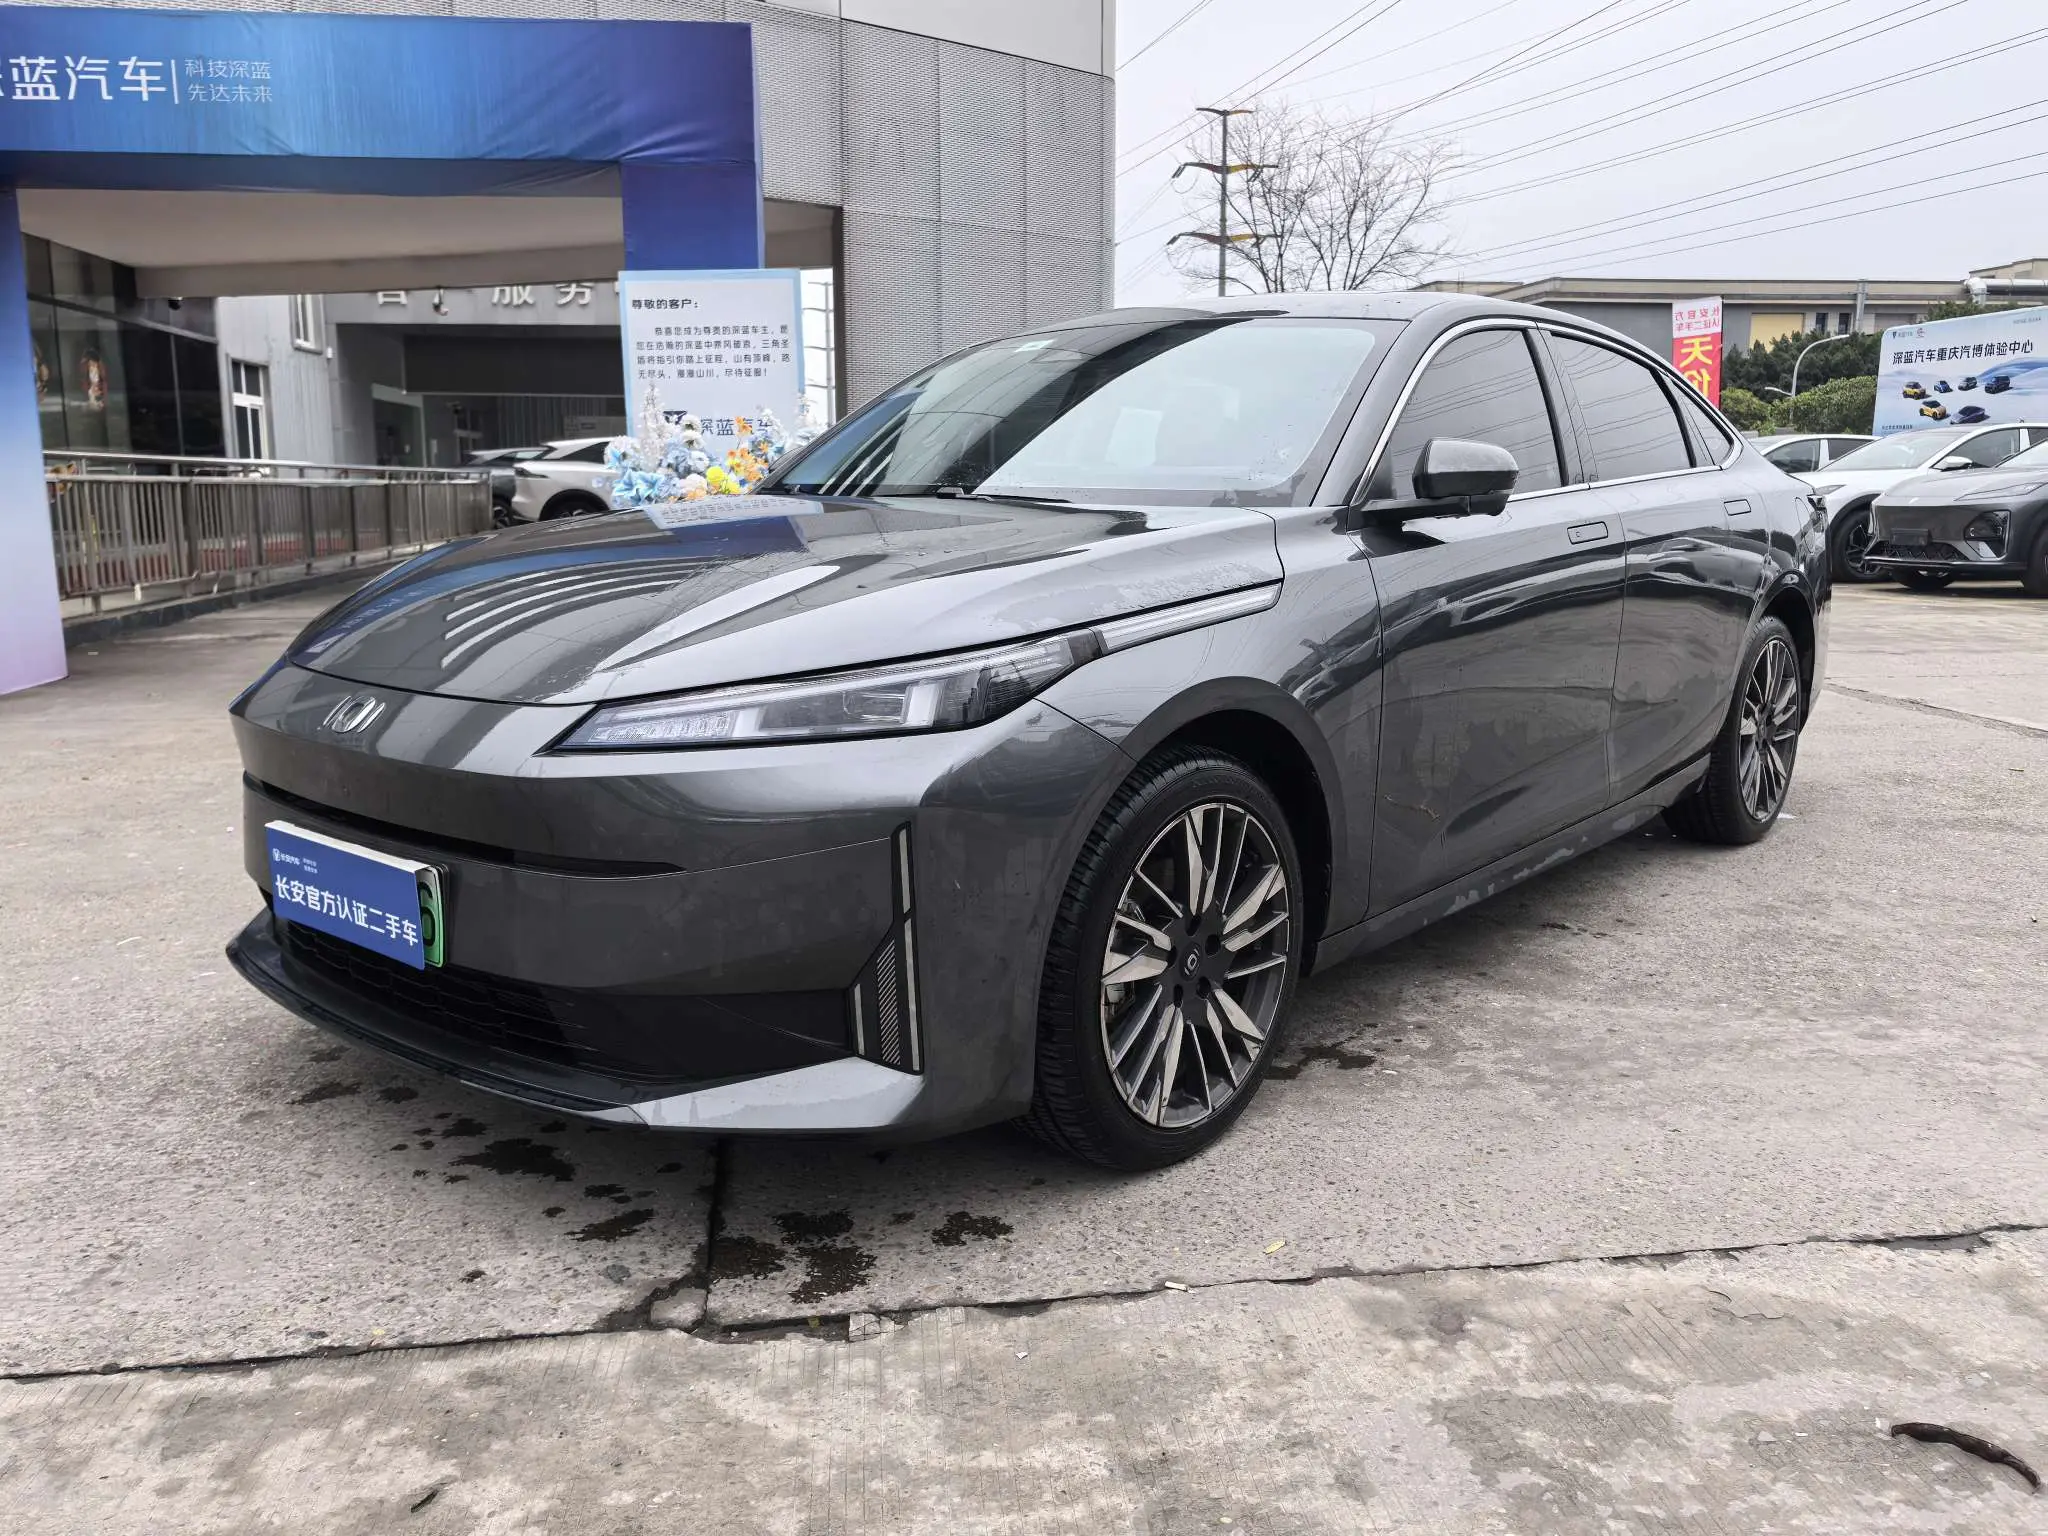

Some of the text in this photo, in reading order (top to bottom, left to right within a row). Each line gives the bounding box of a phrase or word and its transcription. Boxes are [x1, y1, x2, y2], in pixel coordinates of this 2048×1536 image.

[184, 58, 272, 80] 科技深蓝
[187, 84, 273, 103] 先达未来
[631, 299, 699, 310] 尊敬的客户：
[1892, 339, 2034, 365] 深蓝汽车重庆汽博体验中心
[275, 874, 419, 947] 长安官方认证二手车
